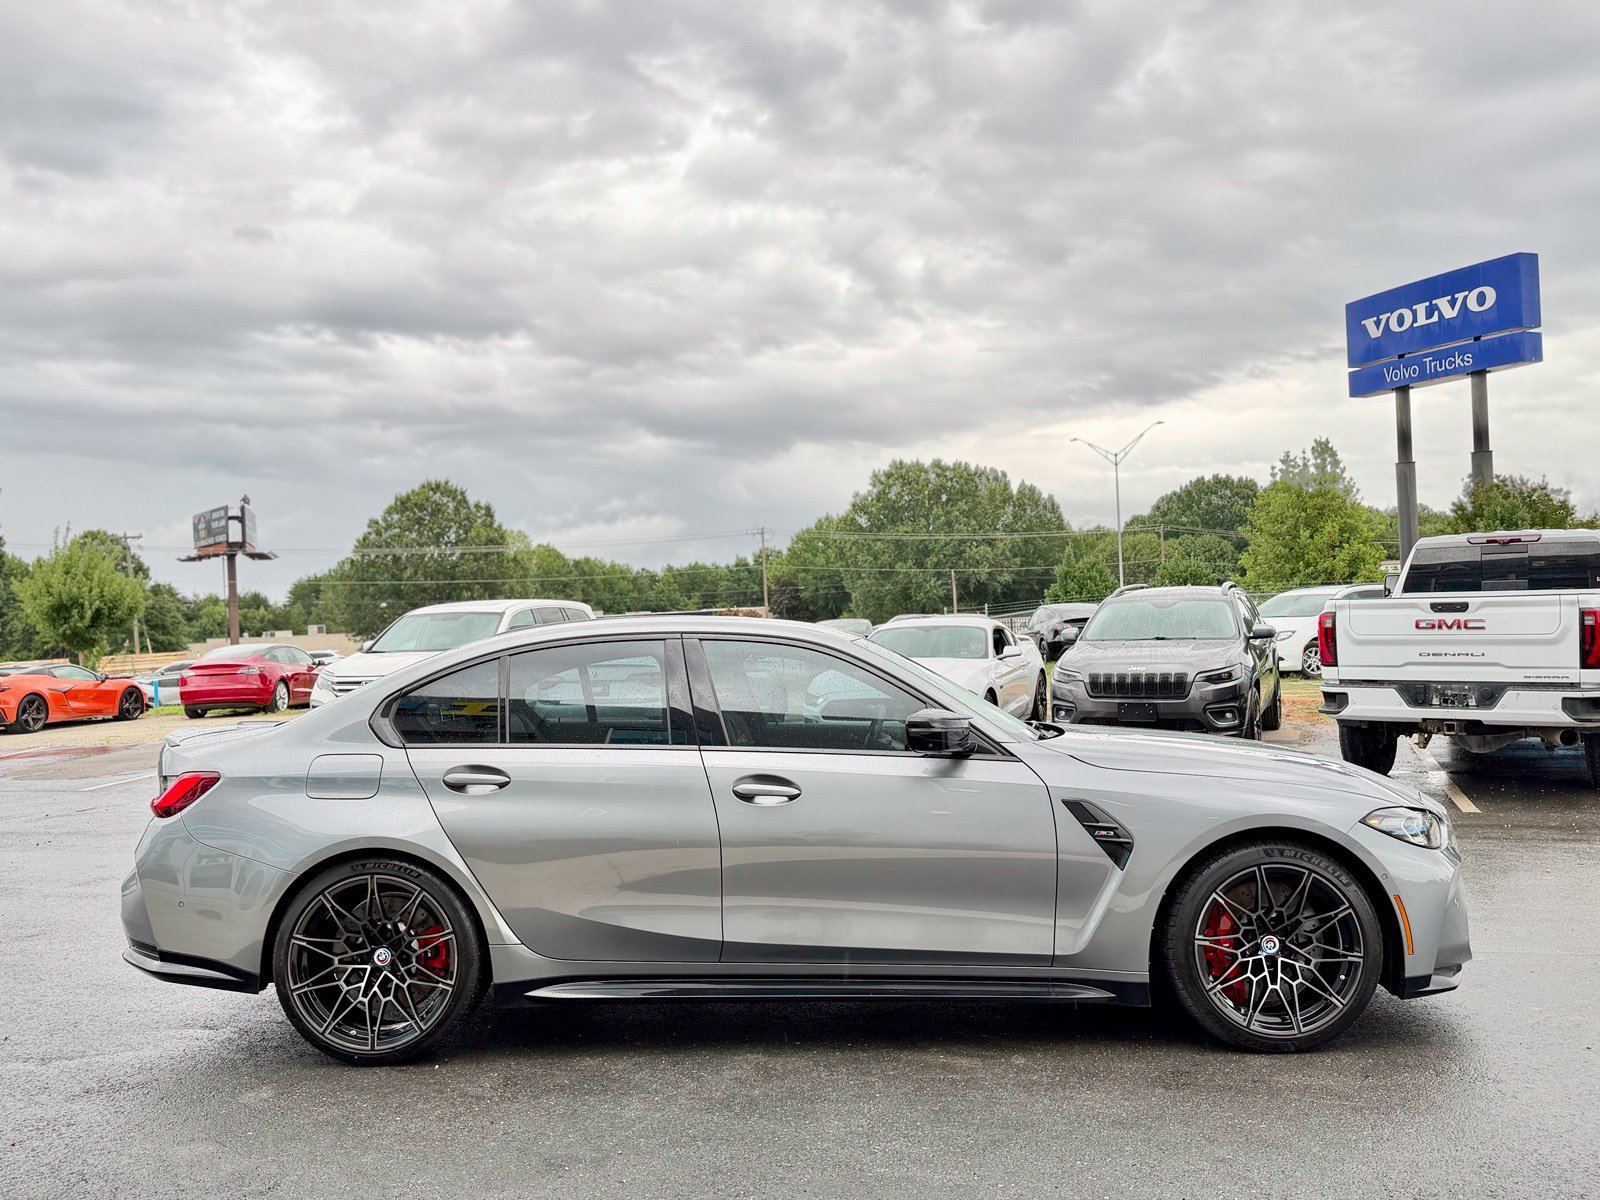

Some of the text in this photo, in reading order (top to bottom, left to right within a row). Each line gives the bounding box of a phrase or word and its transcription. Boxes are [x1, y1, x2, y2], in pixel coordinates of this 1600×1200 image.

[1361, 285, 1497, 339] VOLVO
[1384, 352, 1473, 383] Volvo Trucks
[1415, 618, 1486, 630] GMC
[364, 862, 420, 878] MICHELIN
[1283, 848, 1350, 886] MICHELIN
